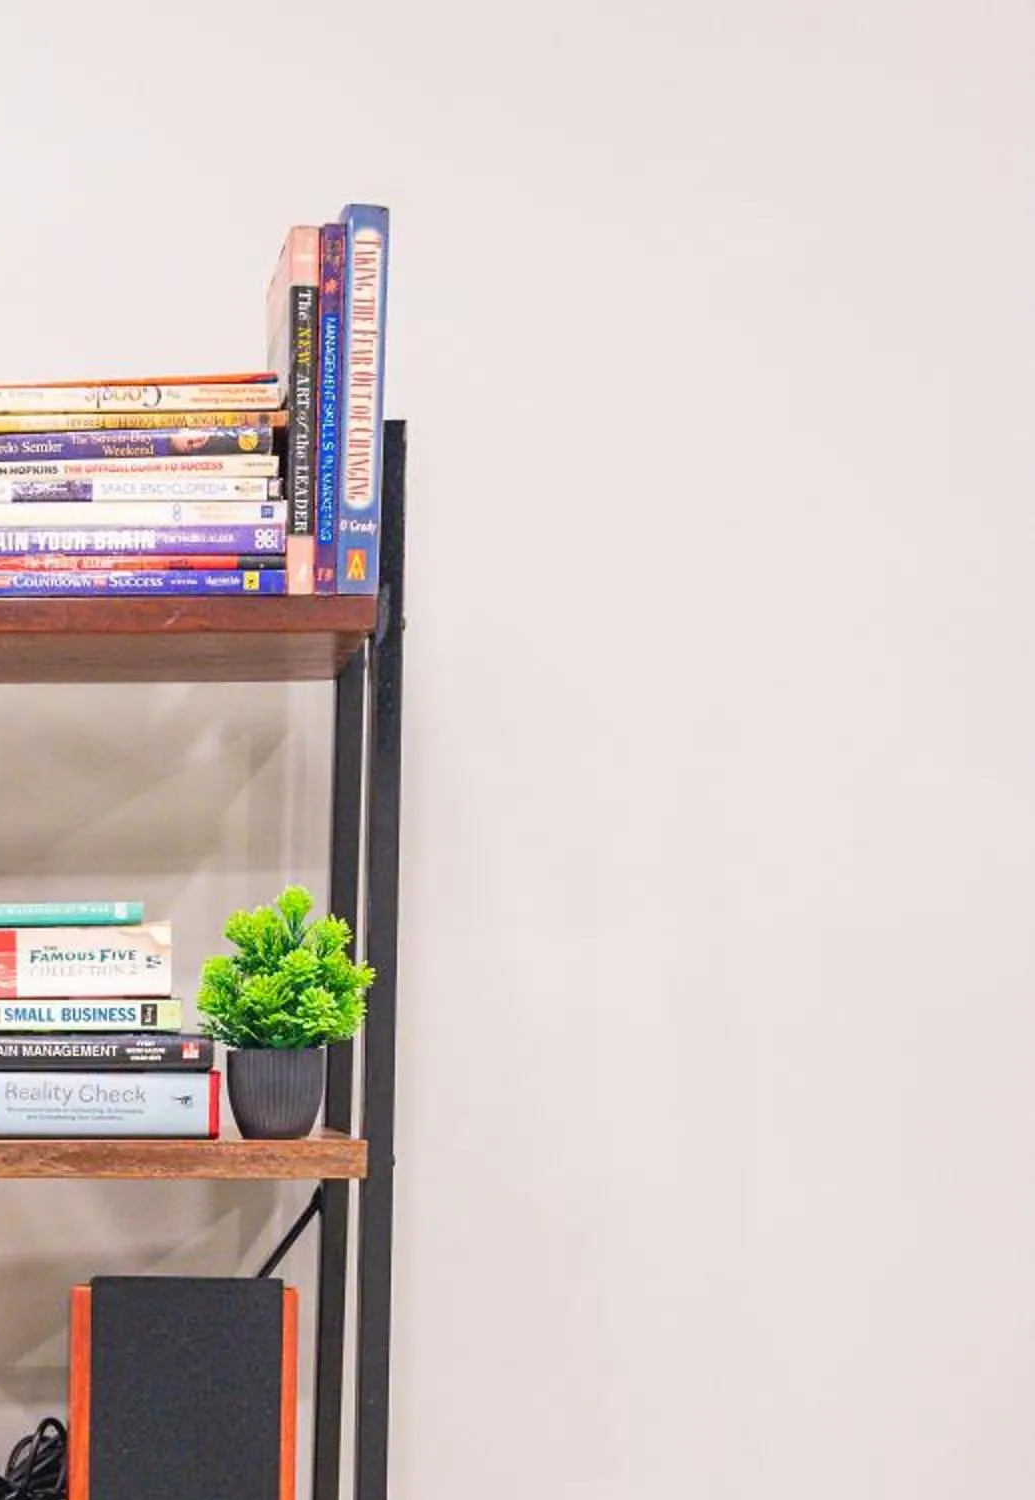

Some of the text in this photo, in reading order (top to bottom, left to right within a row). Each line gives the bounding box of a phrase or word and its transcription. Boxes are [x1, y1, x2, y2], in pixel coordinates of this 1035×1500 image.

[323, 316, 338, 401] MANAGEMENT
[347, 240, 381, 501] TAKING THE FEAR OUT OF CHANGING
[84, 386, 163, 409] Google
[294, 290, 312, 533] The NEW ART of the LEADER
[321, 402, 336, 451] SKILLS
[21, 440, 64, 454] Semler
[102, 443, 155, 456] Weekend
[9, 465, 59, 476] HOPKINS
[3, 1004, 56, 1023] SMALL
[60, 1004, 137, 1023] BUSINESS
[20, 1044, 119, 1058] MANAGEMENT
[4, 1082, 147, 1108] Reality Check
